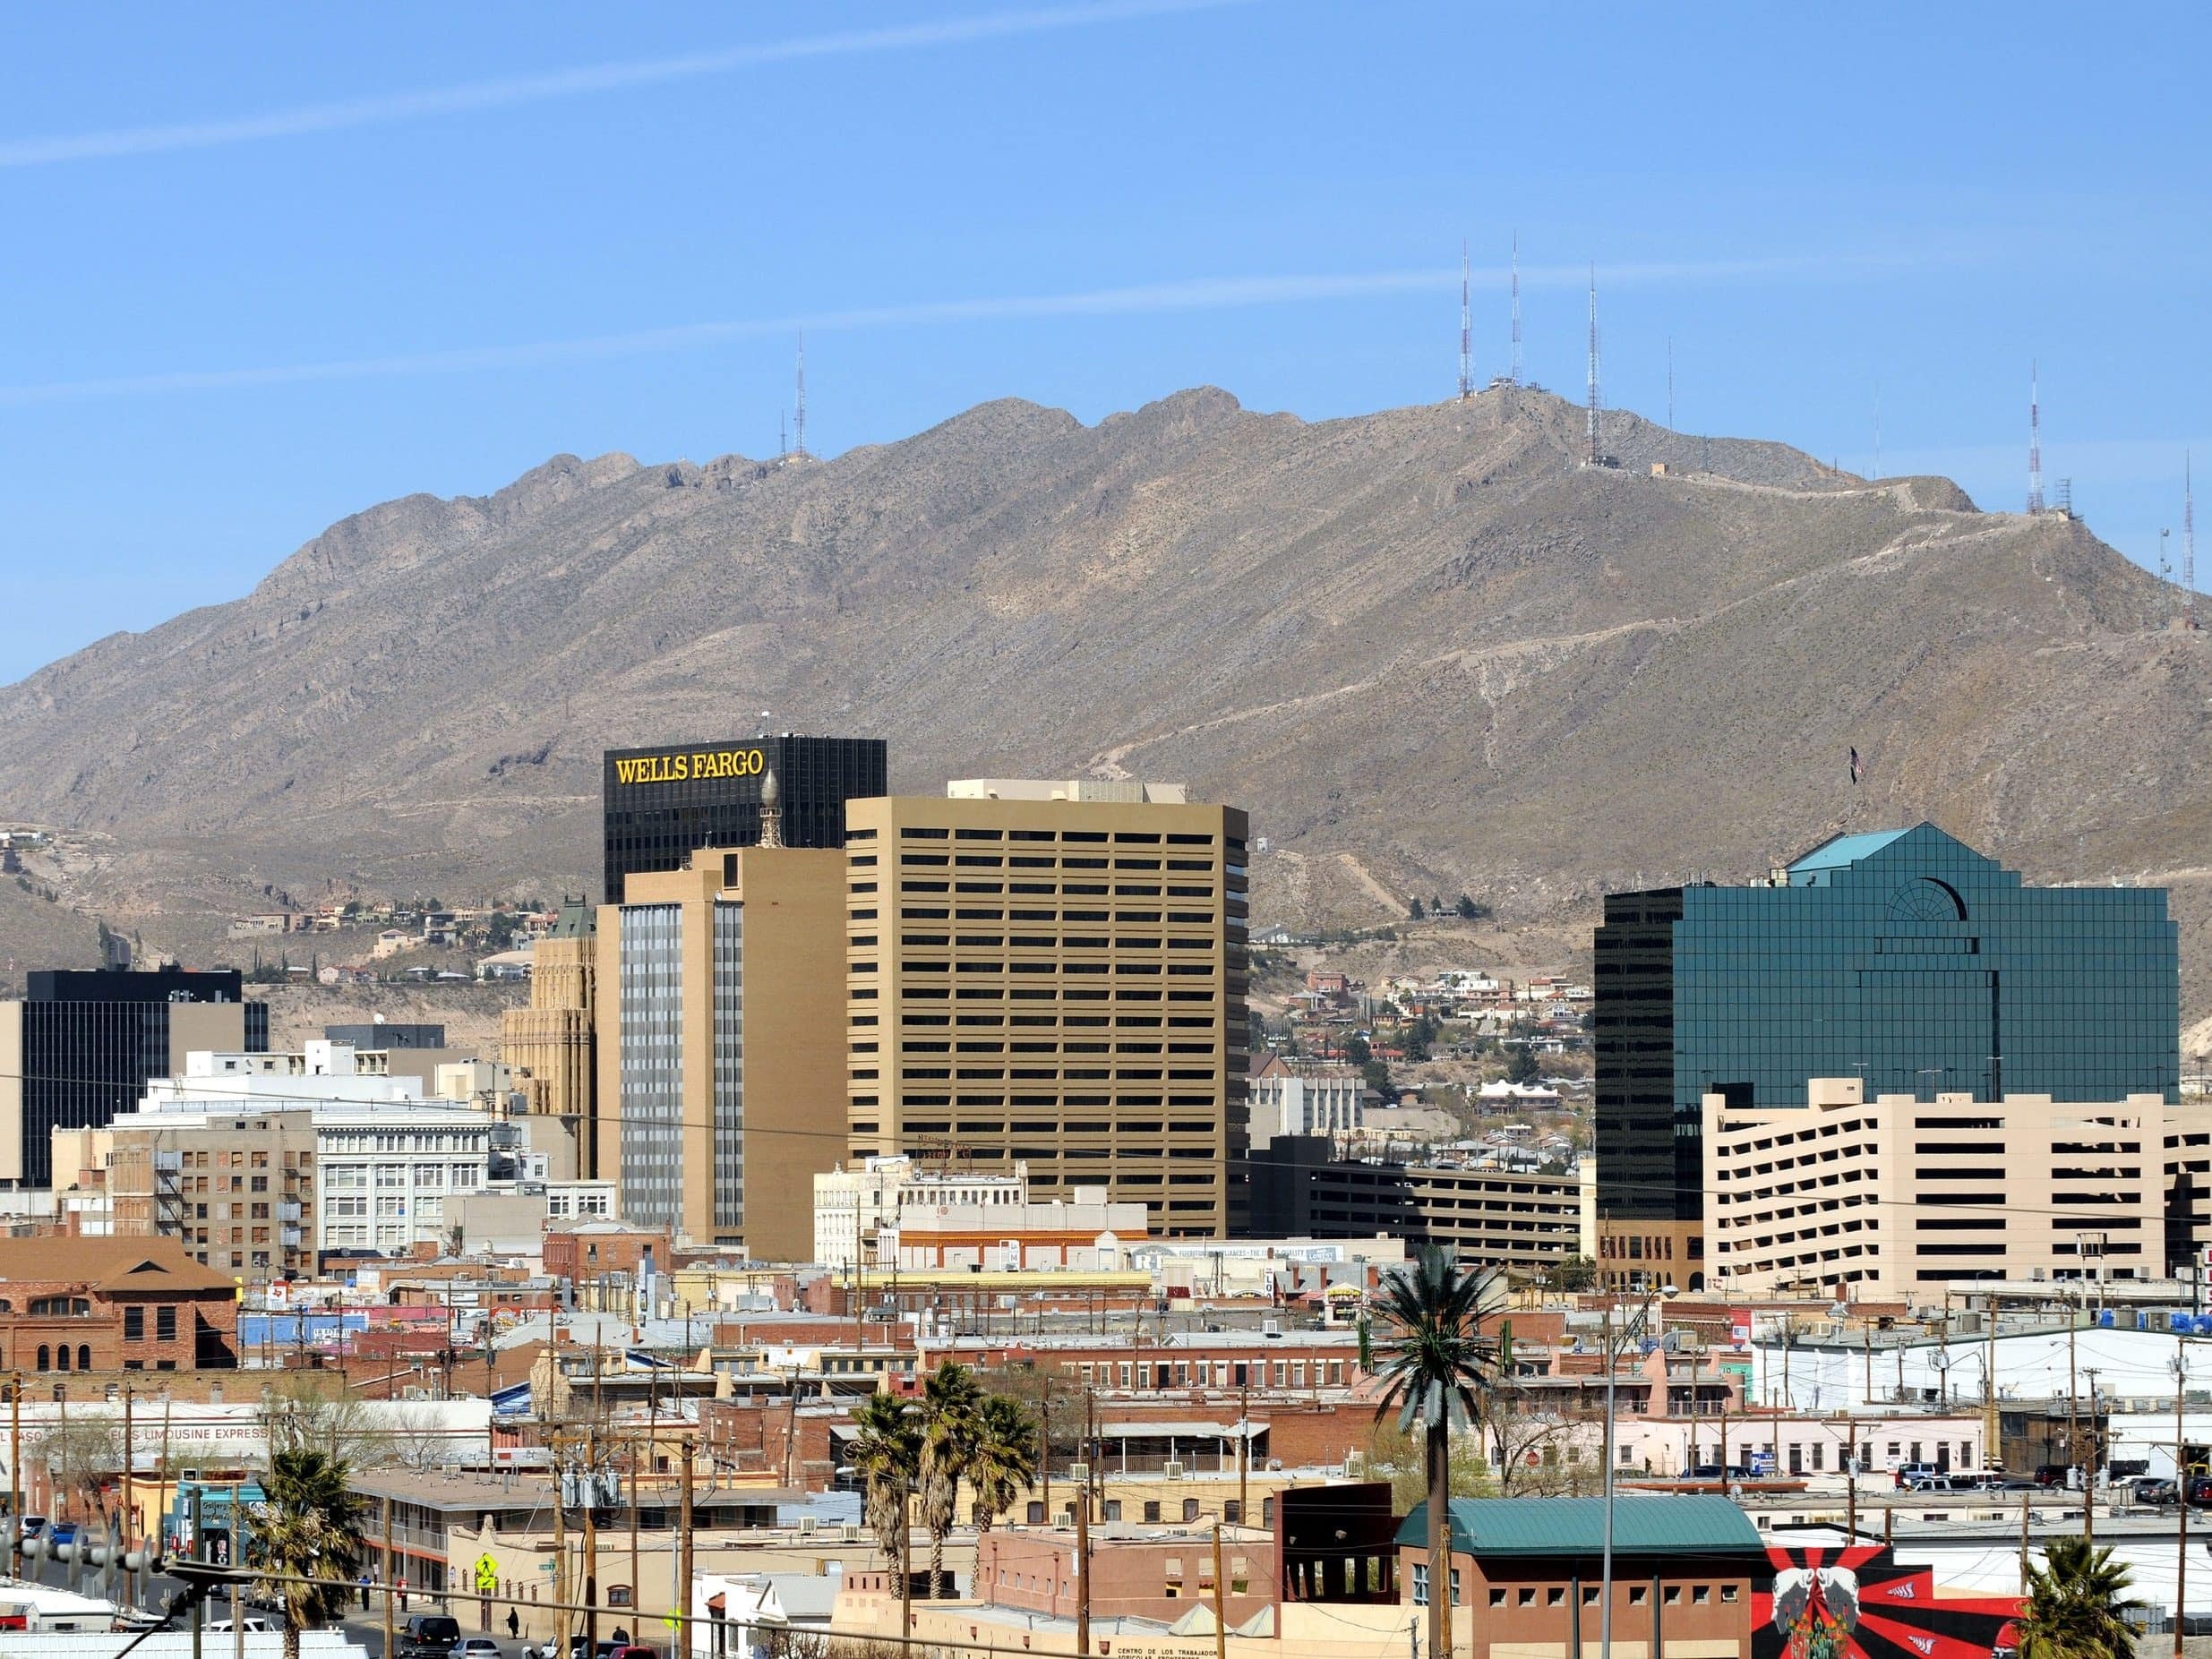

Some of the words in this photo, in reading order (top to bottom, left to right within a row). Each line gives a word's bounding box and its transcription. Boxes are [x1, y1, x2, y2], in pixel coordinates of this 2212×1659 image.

[615, 756, 689, 784] WELLS
[691, 748, 764, 779] FARGO
[11, 1432, 43, 1441] ASO
[143, 1429, 210, 1440] LIMOUSINE
[215, 1428, 269, 1439] EXPRESS
